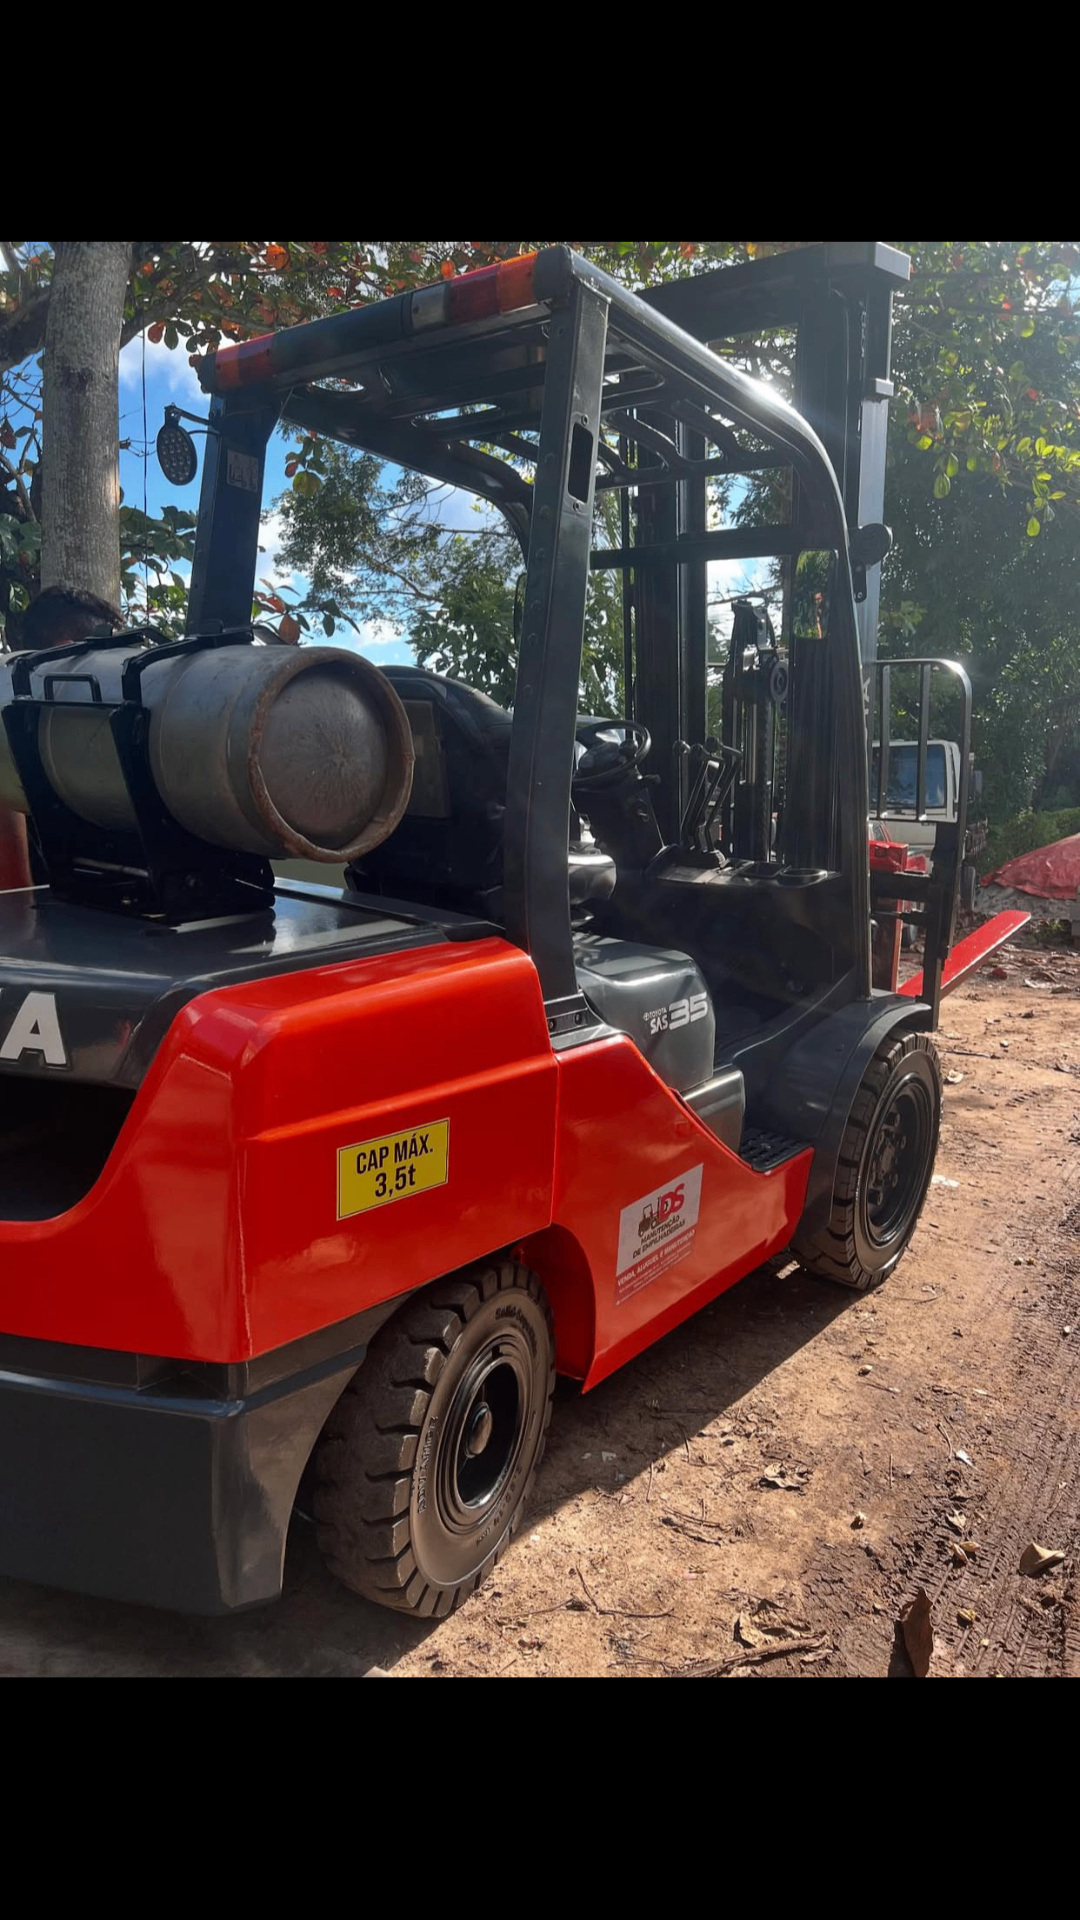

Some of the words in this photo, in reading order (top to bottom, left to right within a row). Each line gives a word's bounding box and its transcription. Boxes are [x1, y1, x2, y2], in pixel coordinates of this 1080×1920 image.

[0, 988, 66, 1065] A
[649, 1007, 667, 1018] TOYOTA
[650, 1014, 668, 1035] SAS
[669, 991, 708, 1030] 35
[356, 1147, 389, 1174] CAP
[394, 1132, 434, 1164] MÁX.
[375, 1163, 416, 1197] 3,5t
[641, 1214, 680, 1244] MANUTENÇÃO
[632, 1247, 641, 1259] DE
